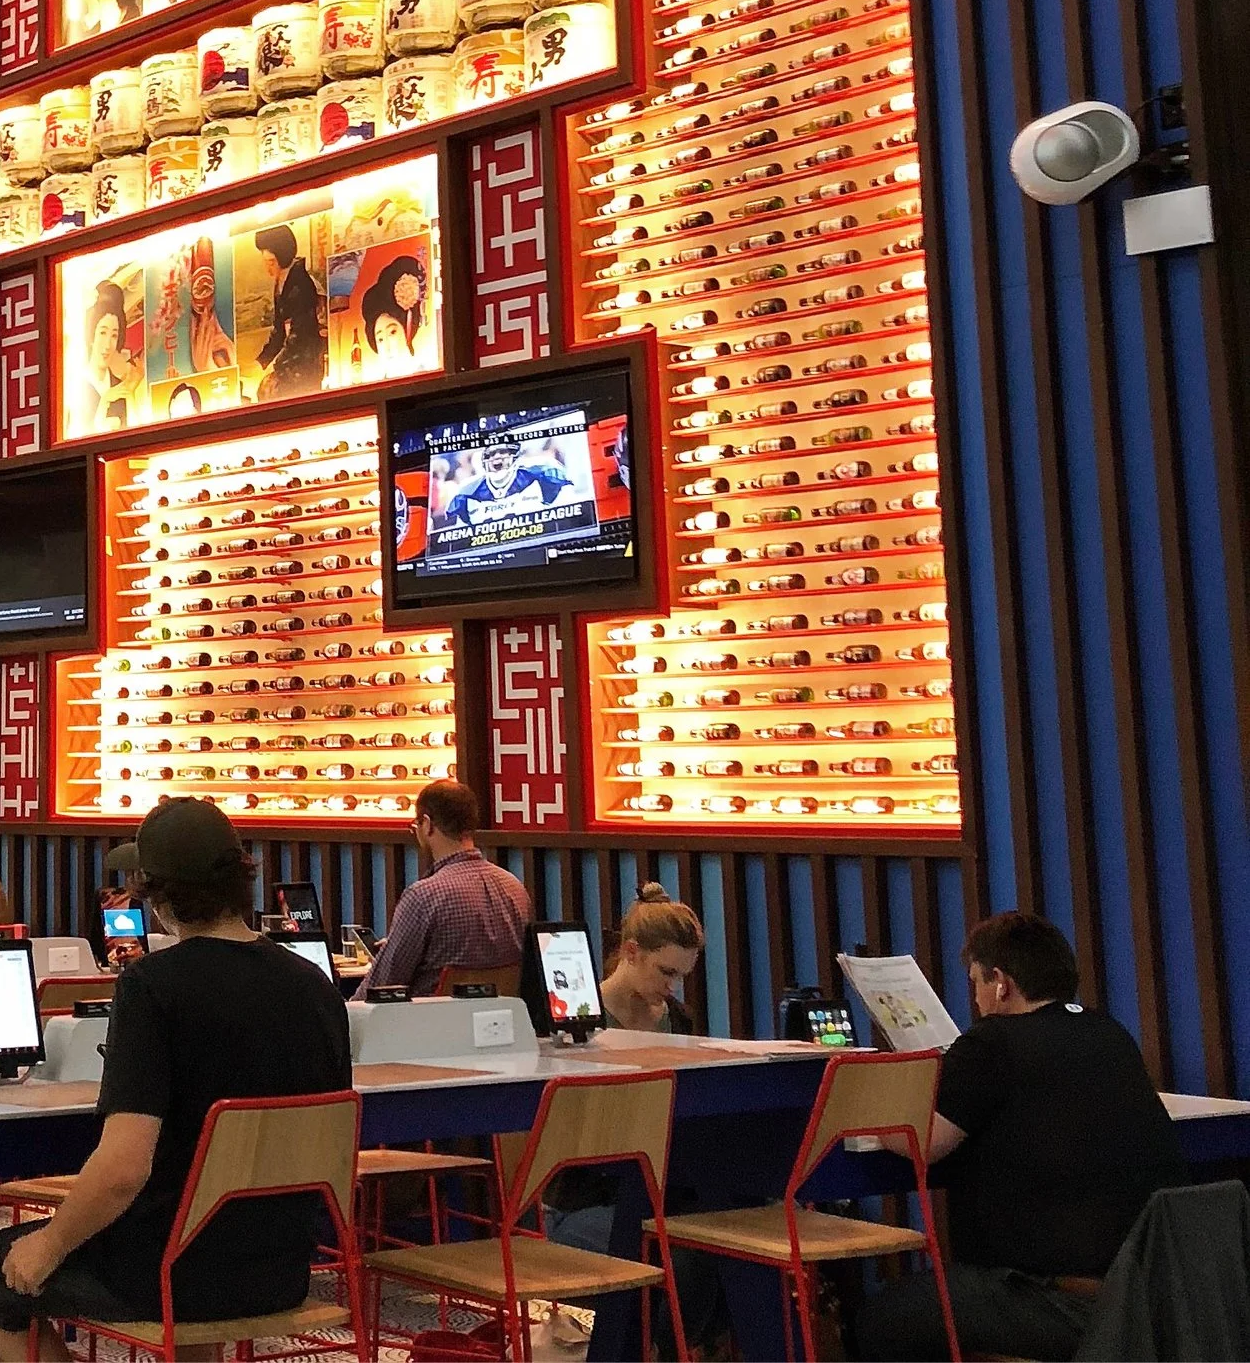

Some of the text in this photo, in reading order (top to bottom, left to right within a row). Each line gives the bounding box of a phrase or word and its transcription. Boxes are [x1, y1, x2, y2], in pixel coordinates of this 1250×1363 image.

[466, 53, 503, 99] 寿
[471, 440, 480, 448] HE
[484, 437, 500, 446] WAS
[513, 431, 544, 442] RECORD
[548, 424, 585, 437] SETTING
[437, 504, 582, 544] ARENA FOOTBALL LEAGUE
[470, 524, 544, 547] 2002, 2004-08
